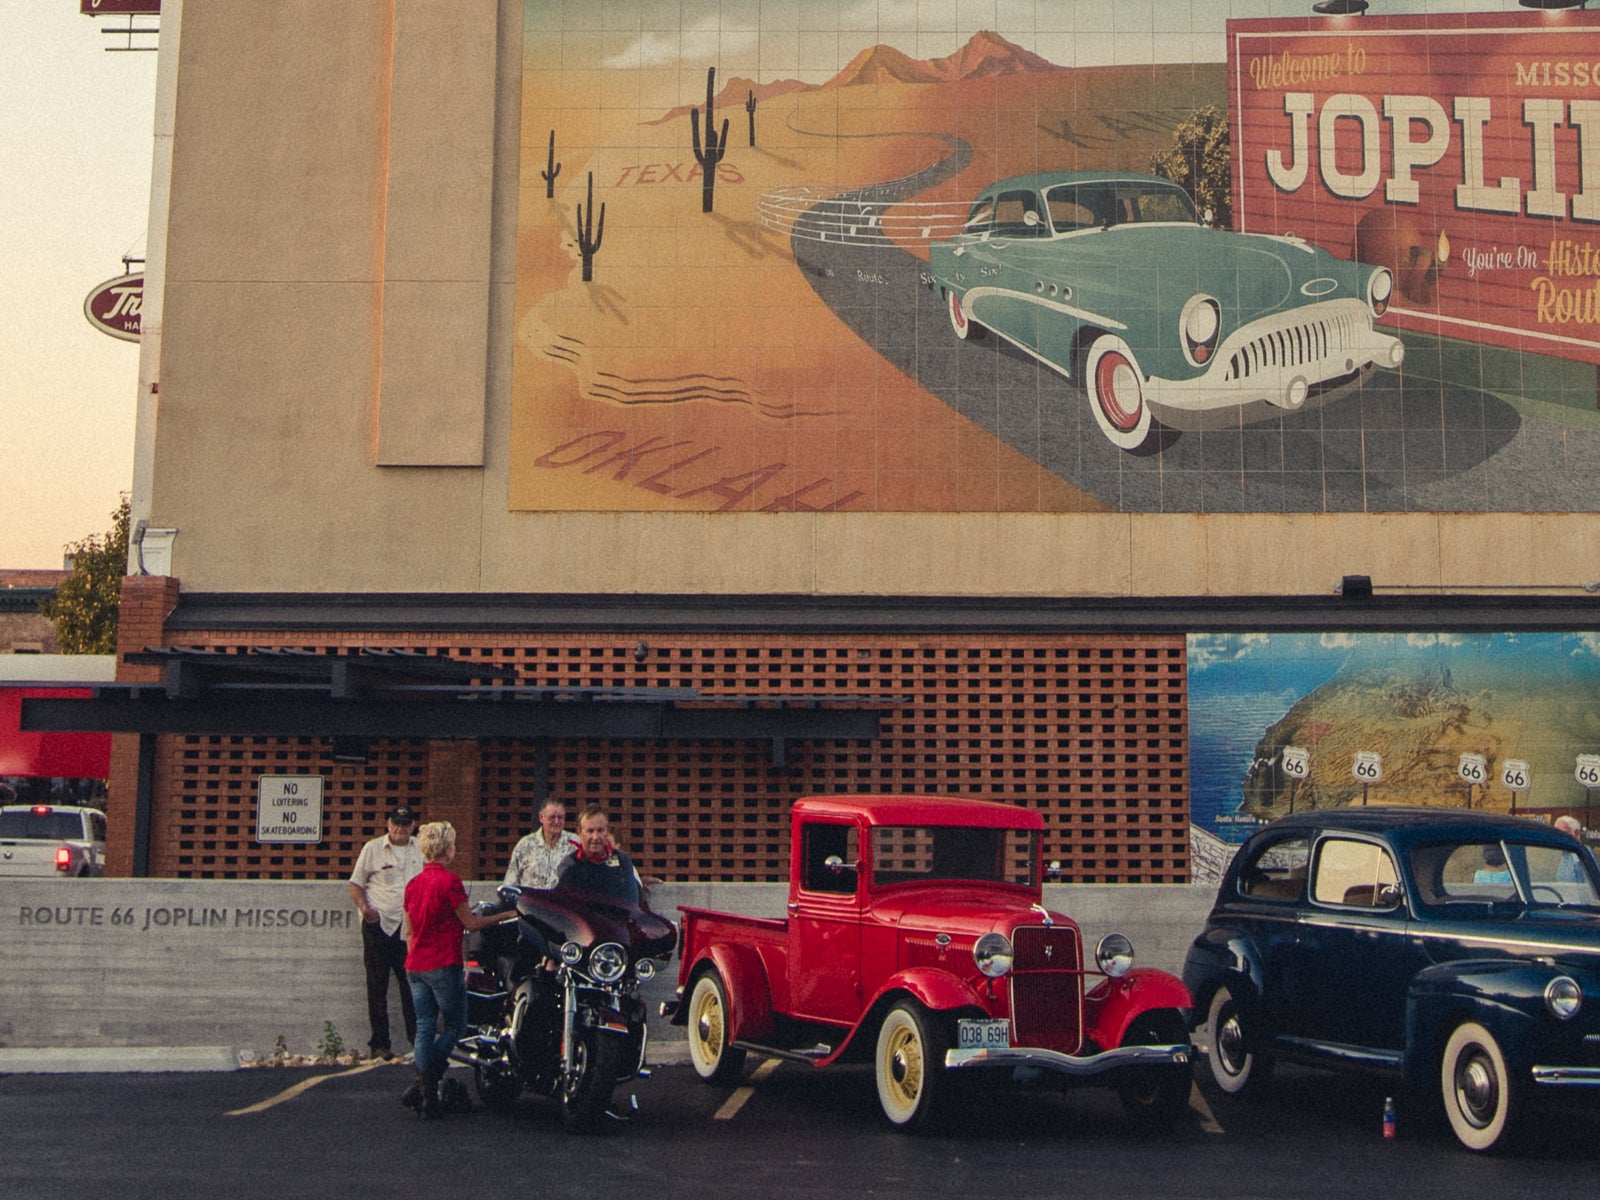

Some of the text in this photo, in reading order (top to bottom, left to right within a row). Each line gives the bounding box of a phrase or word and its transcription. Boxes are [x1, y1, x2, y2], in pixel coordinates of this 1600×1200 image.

[1250, 43, 1366, 90] Welcome to
[1462, 246, 1512, 277] You're
[1517, 246, 1537, 269] On
[1285, 758, 1304, 774] 66
[1357, 762, 1377, 777] 66
[1462, 763, 1481, 779] 66
[1506, 770, 1525, 786] 66
[1579, 767, 1598, 782] 66
[284, 783, 298, 795] NO
[272, 798, 308, 806] LOITERING
[283, 812, 297, 823] NO
[261, 826, 318, 835] SKATEBOARDING
[19, 906, 354, 932] ROUTE 66 JOPLIN MISSOURI
[961, 1026, 1008, 1043] 038 69H
